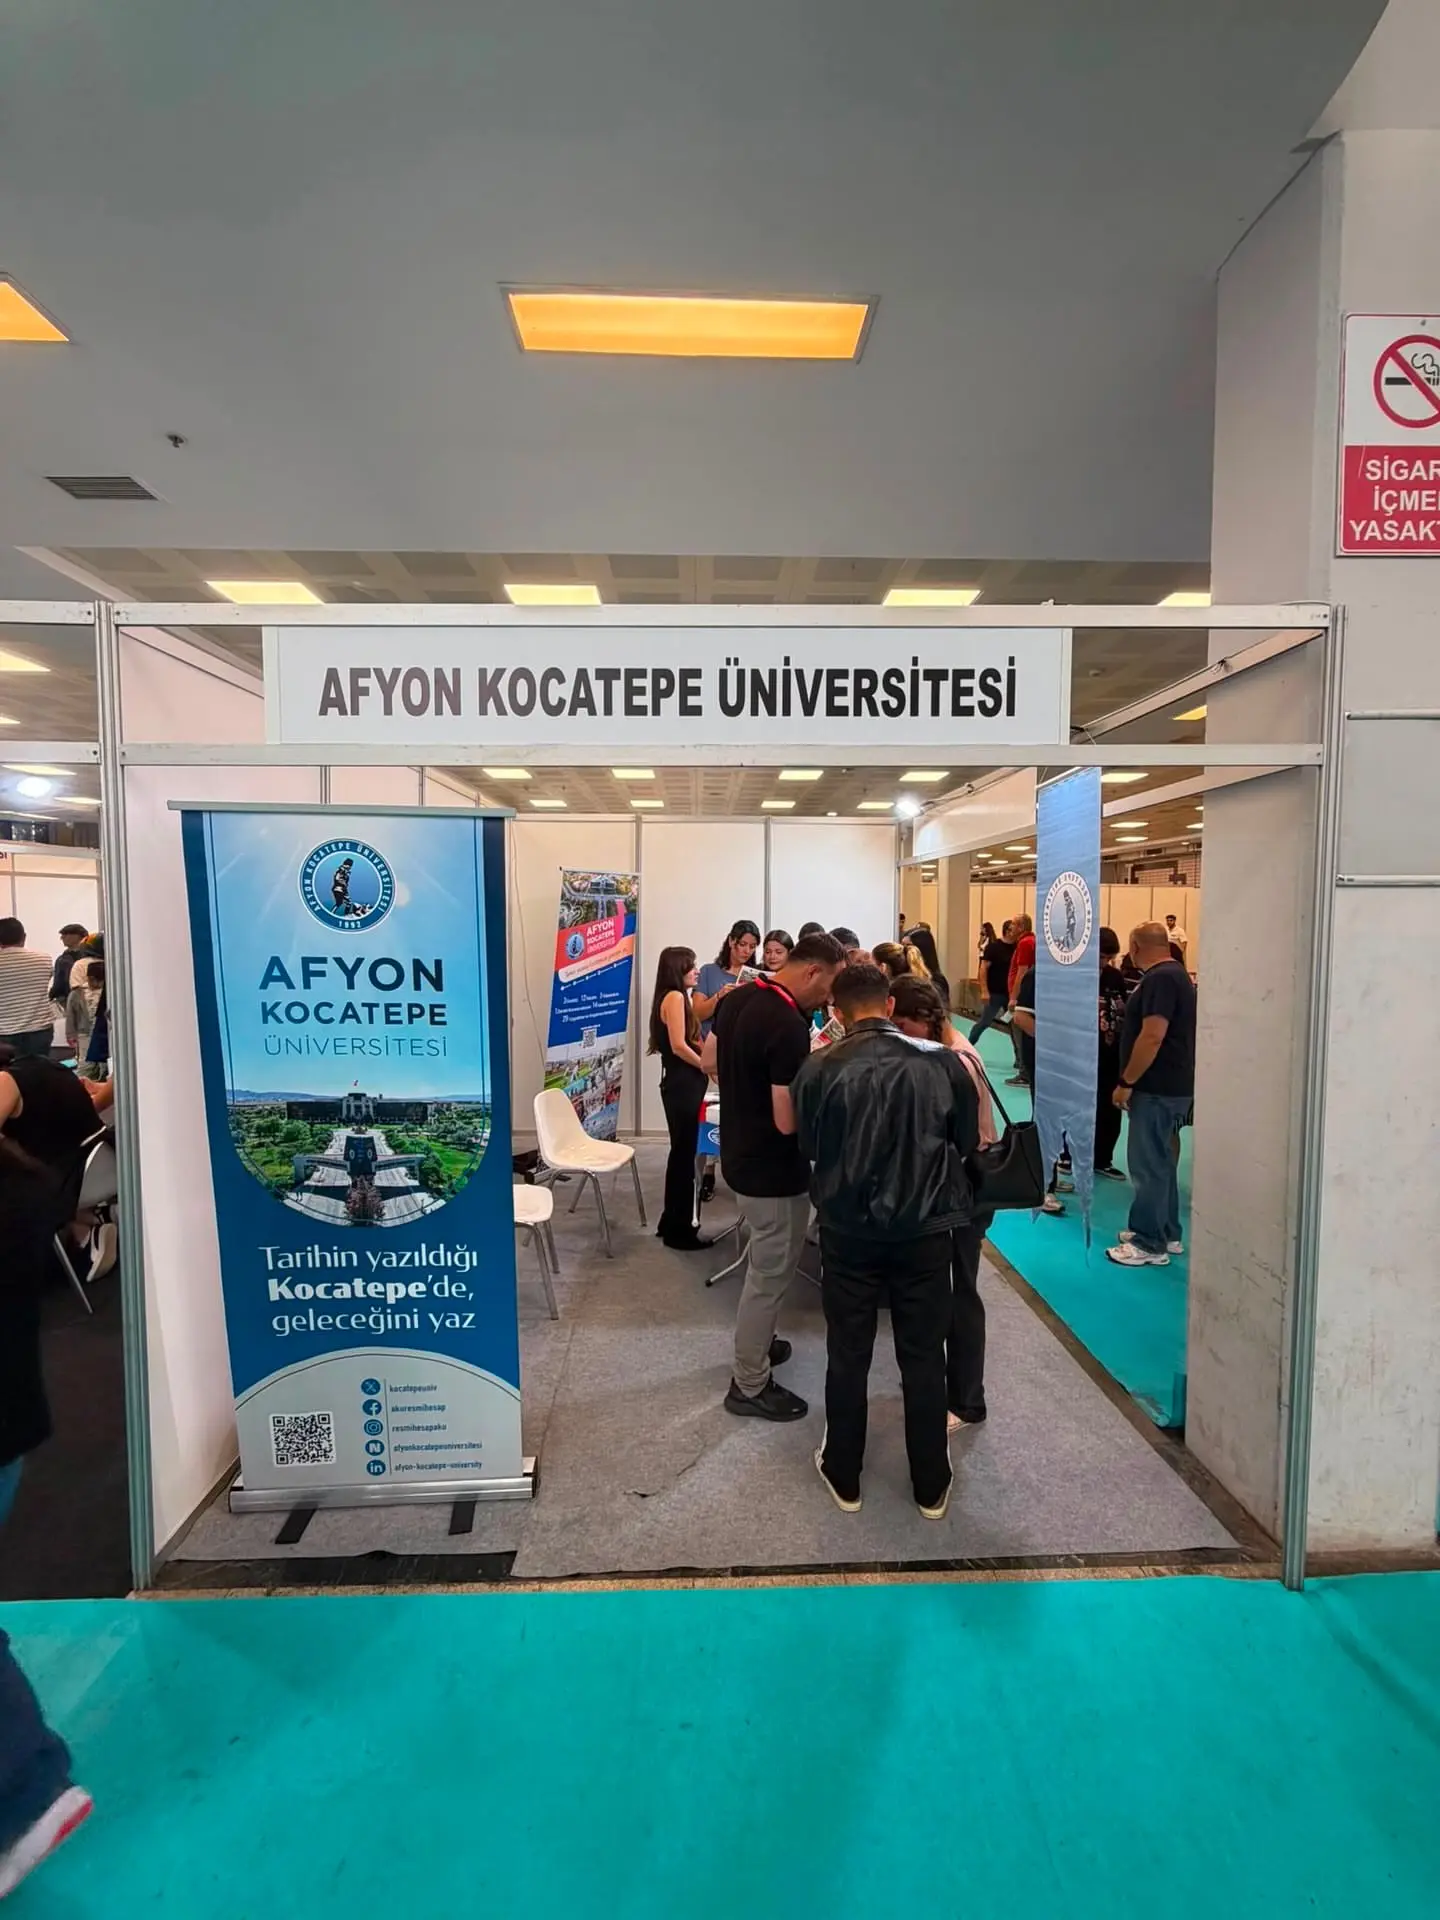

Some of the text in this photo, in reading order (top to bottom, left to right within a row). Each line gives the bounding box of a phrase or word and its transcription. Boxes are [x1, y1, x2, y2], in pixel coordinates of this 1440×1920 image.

[1373, 485, 1440, 516] İÇME
[1349, 519, 1440, 541] YASAK
[318, 656, 1016, 718] AFYON KOCATEPE ÜNİVERSİTESİ
[259, 956, 444, 992] AFYON
[261, 1001, 447, 1026] KOCATEPE
[264, 1034, 447, 1057] ÜNİVERSİTESİ
[258, 1243, 478, 1273] Tarihin yazıldığı
[267, 1275, 474, 1304] Kocatepe'de,
[271, 1307, 476, 1337] geleceğini yaz
